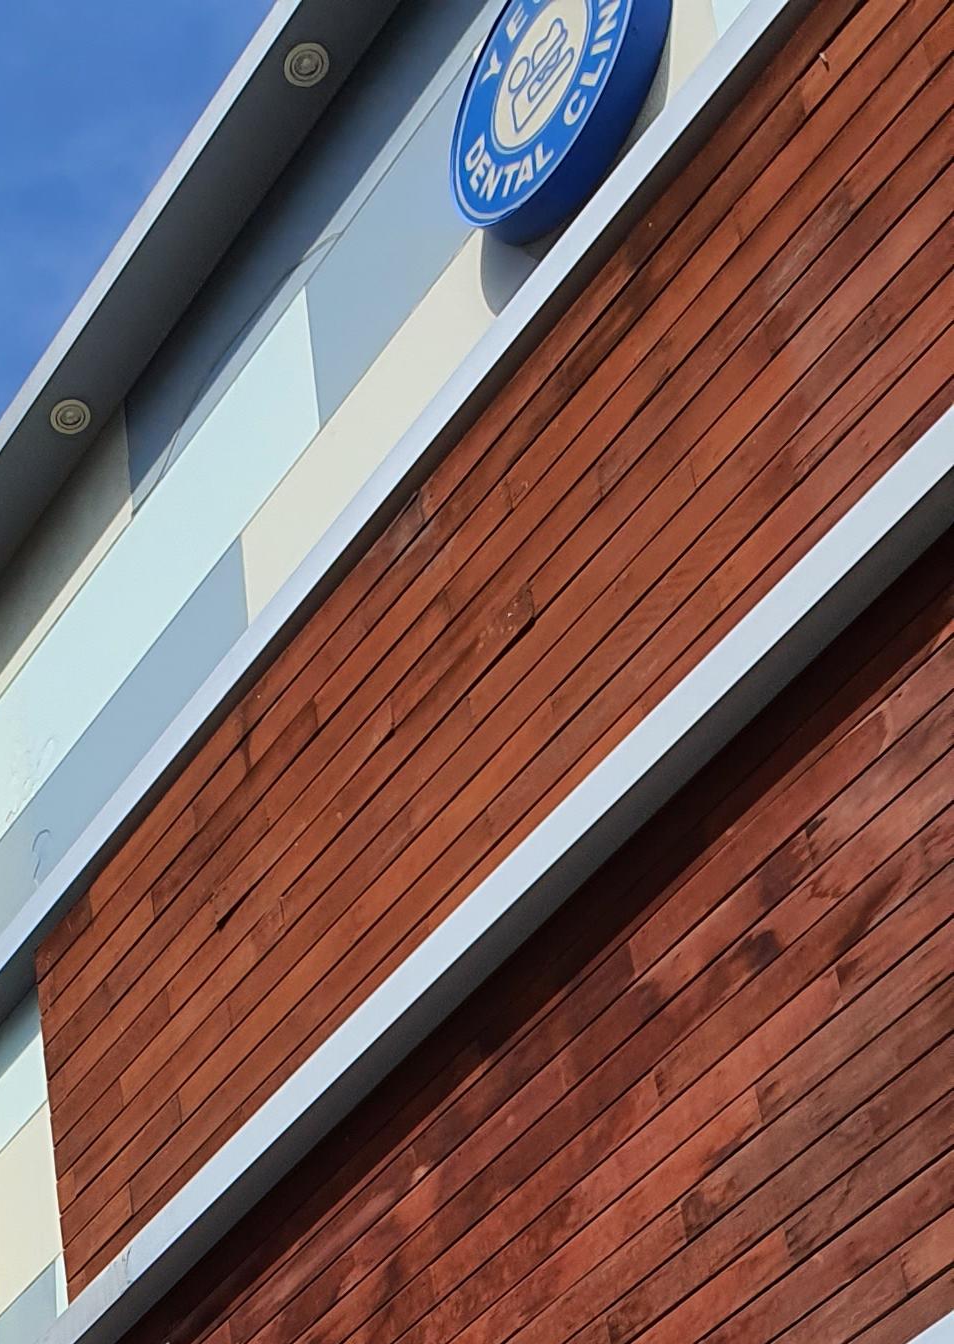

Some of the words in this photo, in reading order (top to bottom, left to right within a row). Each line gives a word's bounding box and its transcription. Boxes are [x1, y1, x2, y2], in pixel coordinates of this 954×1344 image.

[464, 133, 555, 202] DENTAL
[563, 0, 622, 126] CLIN
[479, 0, 542, 86] YE
